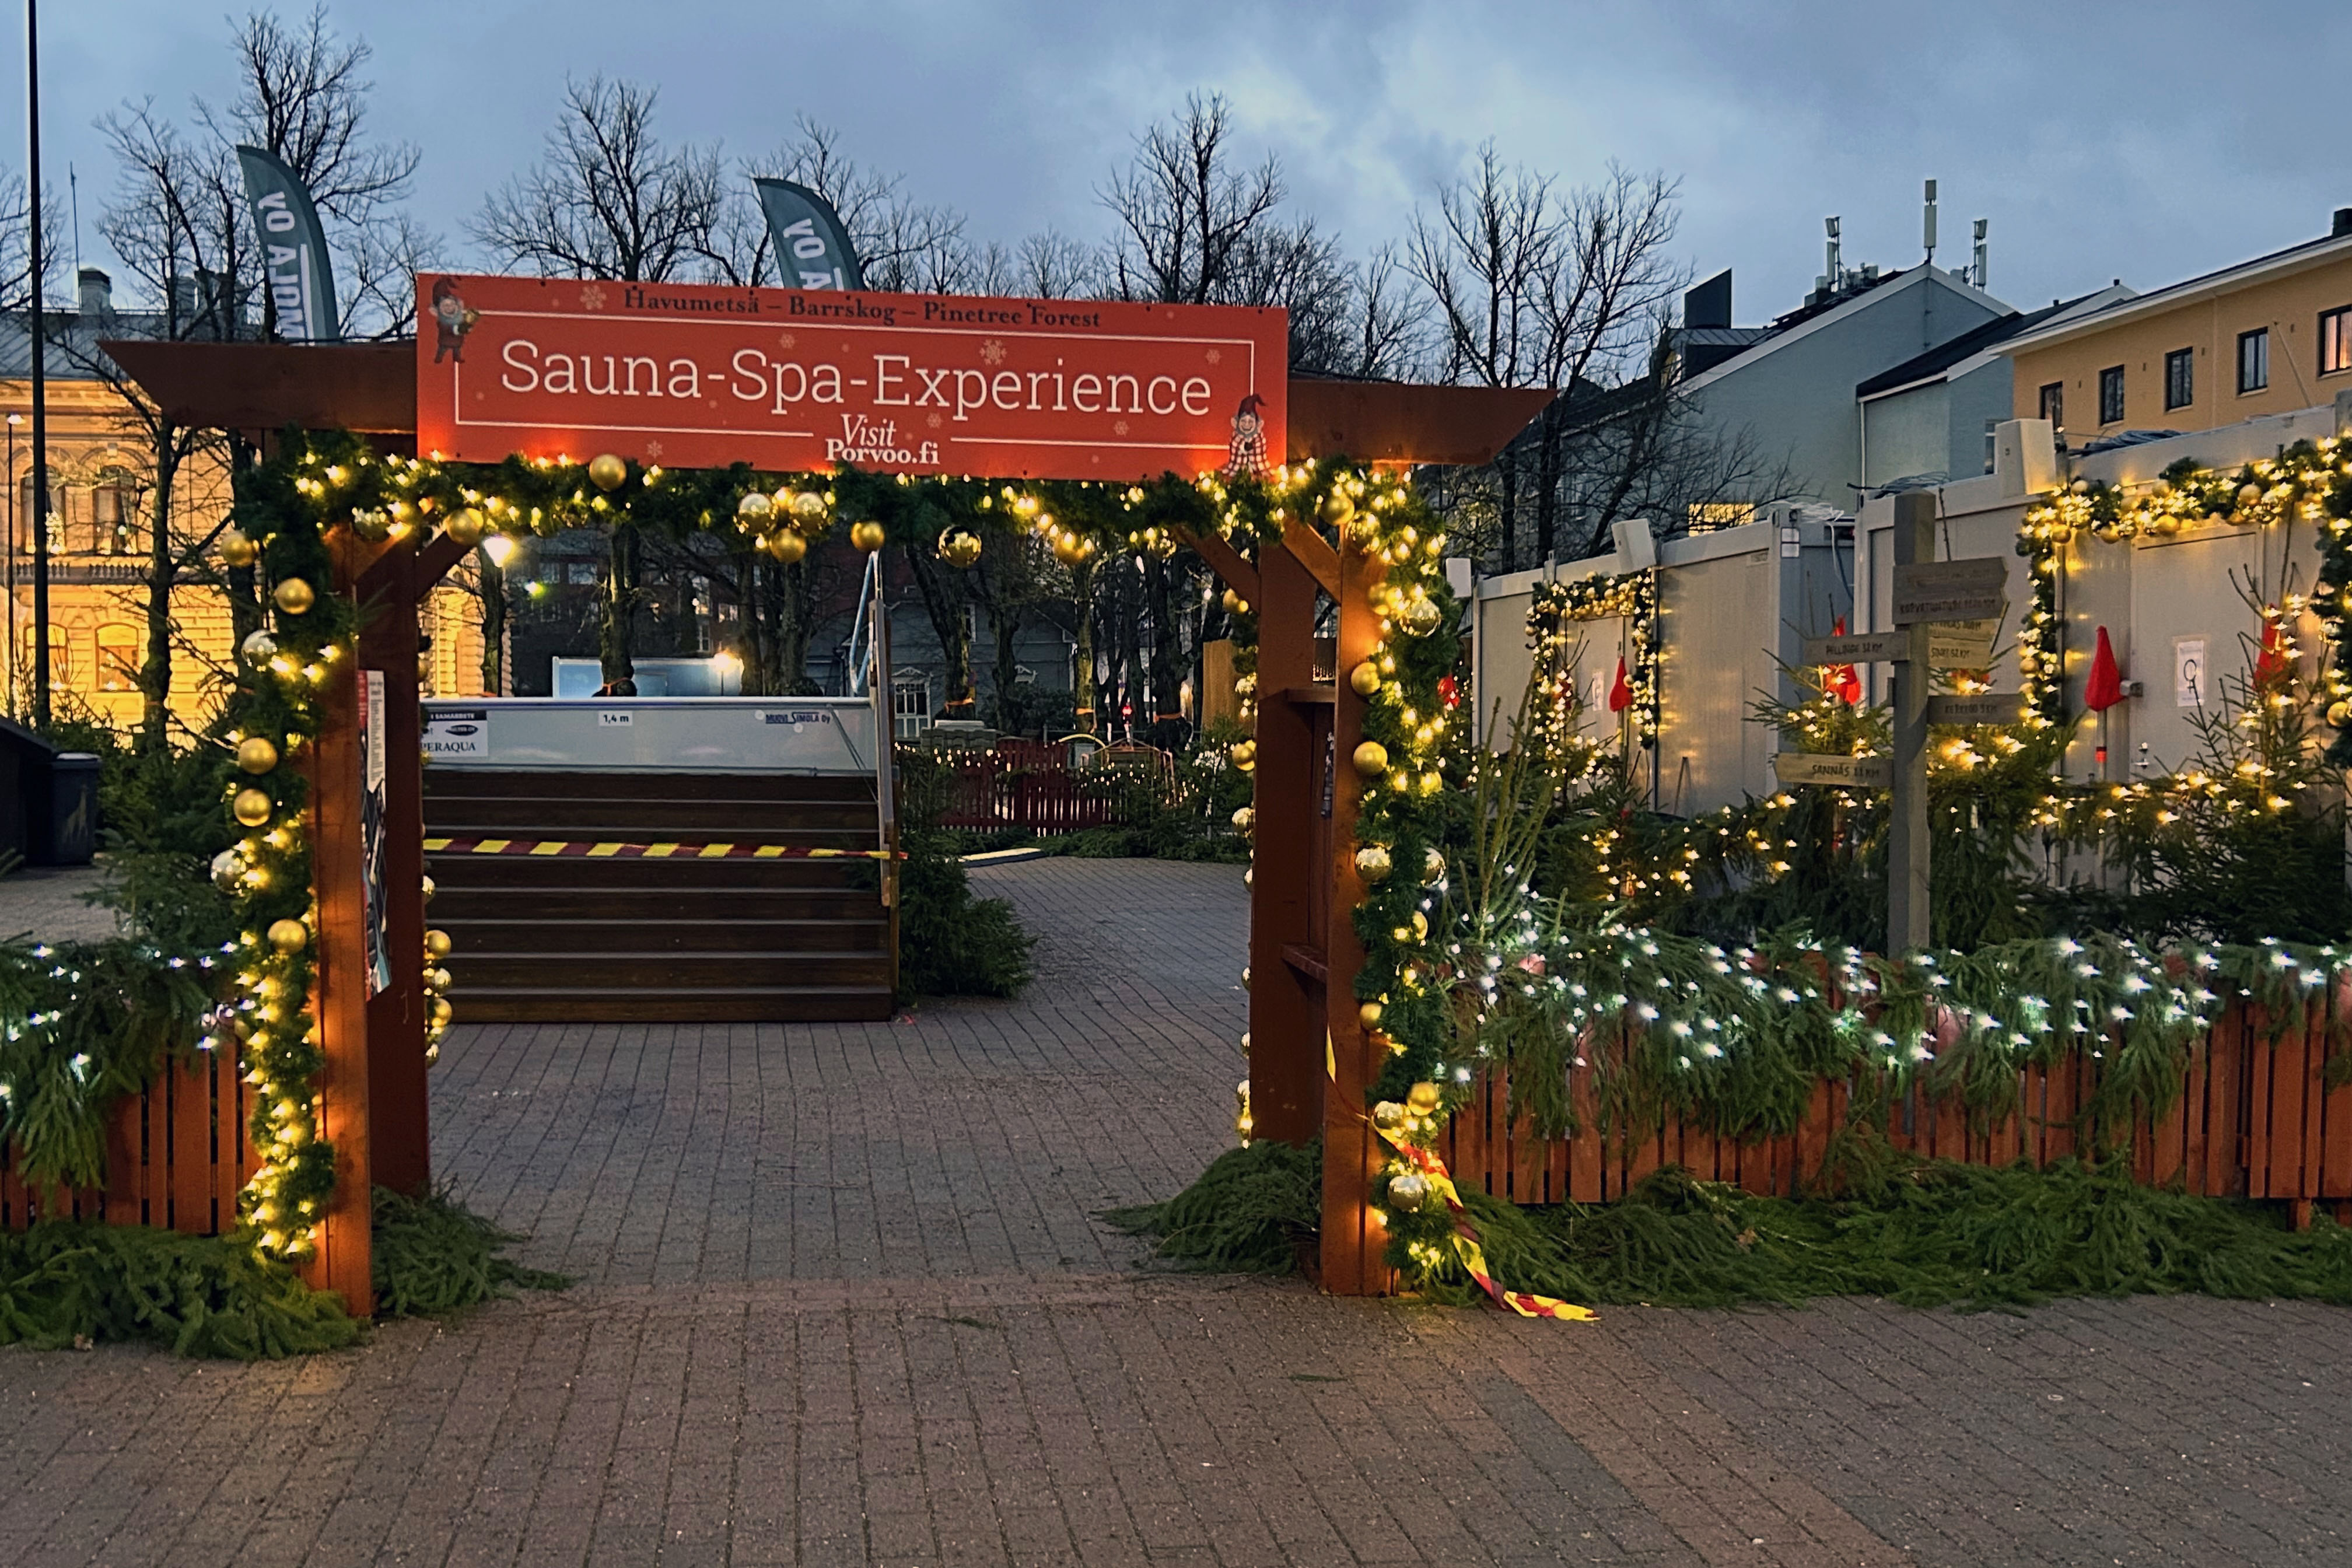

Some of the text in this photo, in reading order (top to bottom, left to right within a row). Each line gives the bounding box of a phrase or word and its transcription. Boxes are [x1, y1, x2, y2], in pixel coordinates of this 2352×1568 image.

[625, 288, 759, 313] Havumetsä
[789, 296, 896, 326] Barrskog
[925, 302, 1023, 324] Pinetree
[1030, 306, 1101, 327] Forest
[502, 339, 1211, 421] Sauna-Spa-Experience
[841, 414, 897, 447] Visit
[825, 439, 940, 464] Porvoo.fi
[603, 713, 617, 724] 1,4
